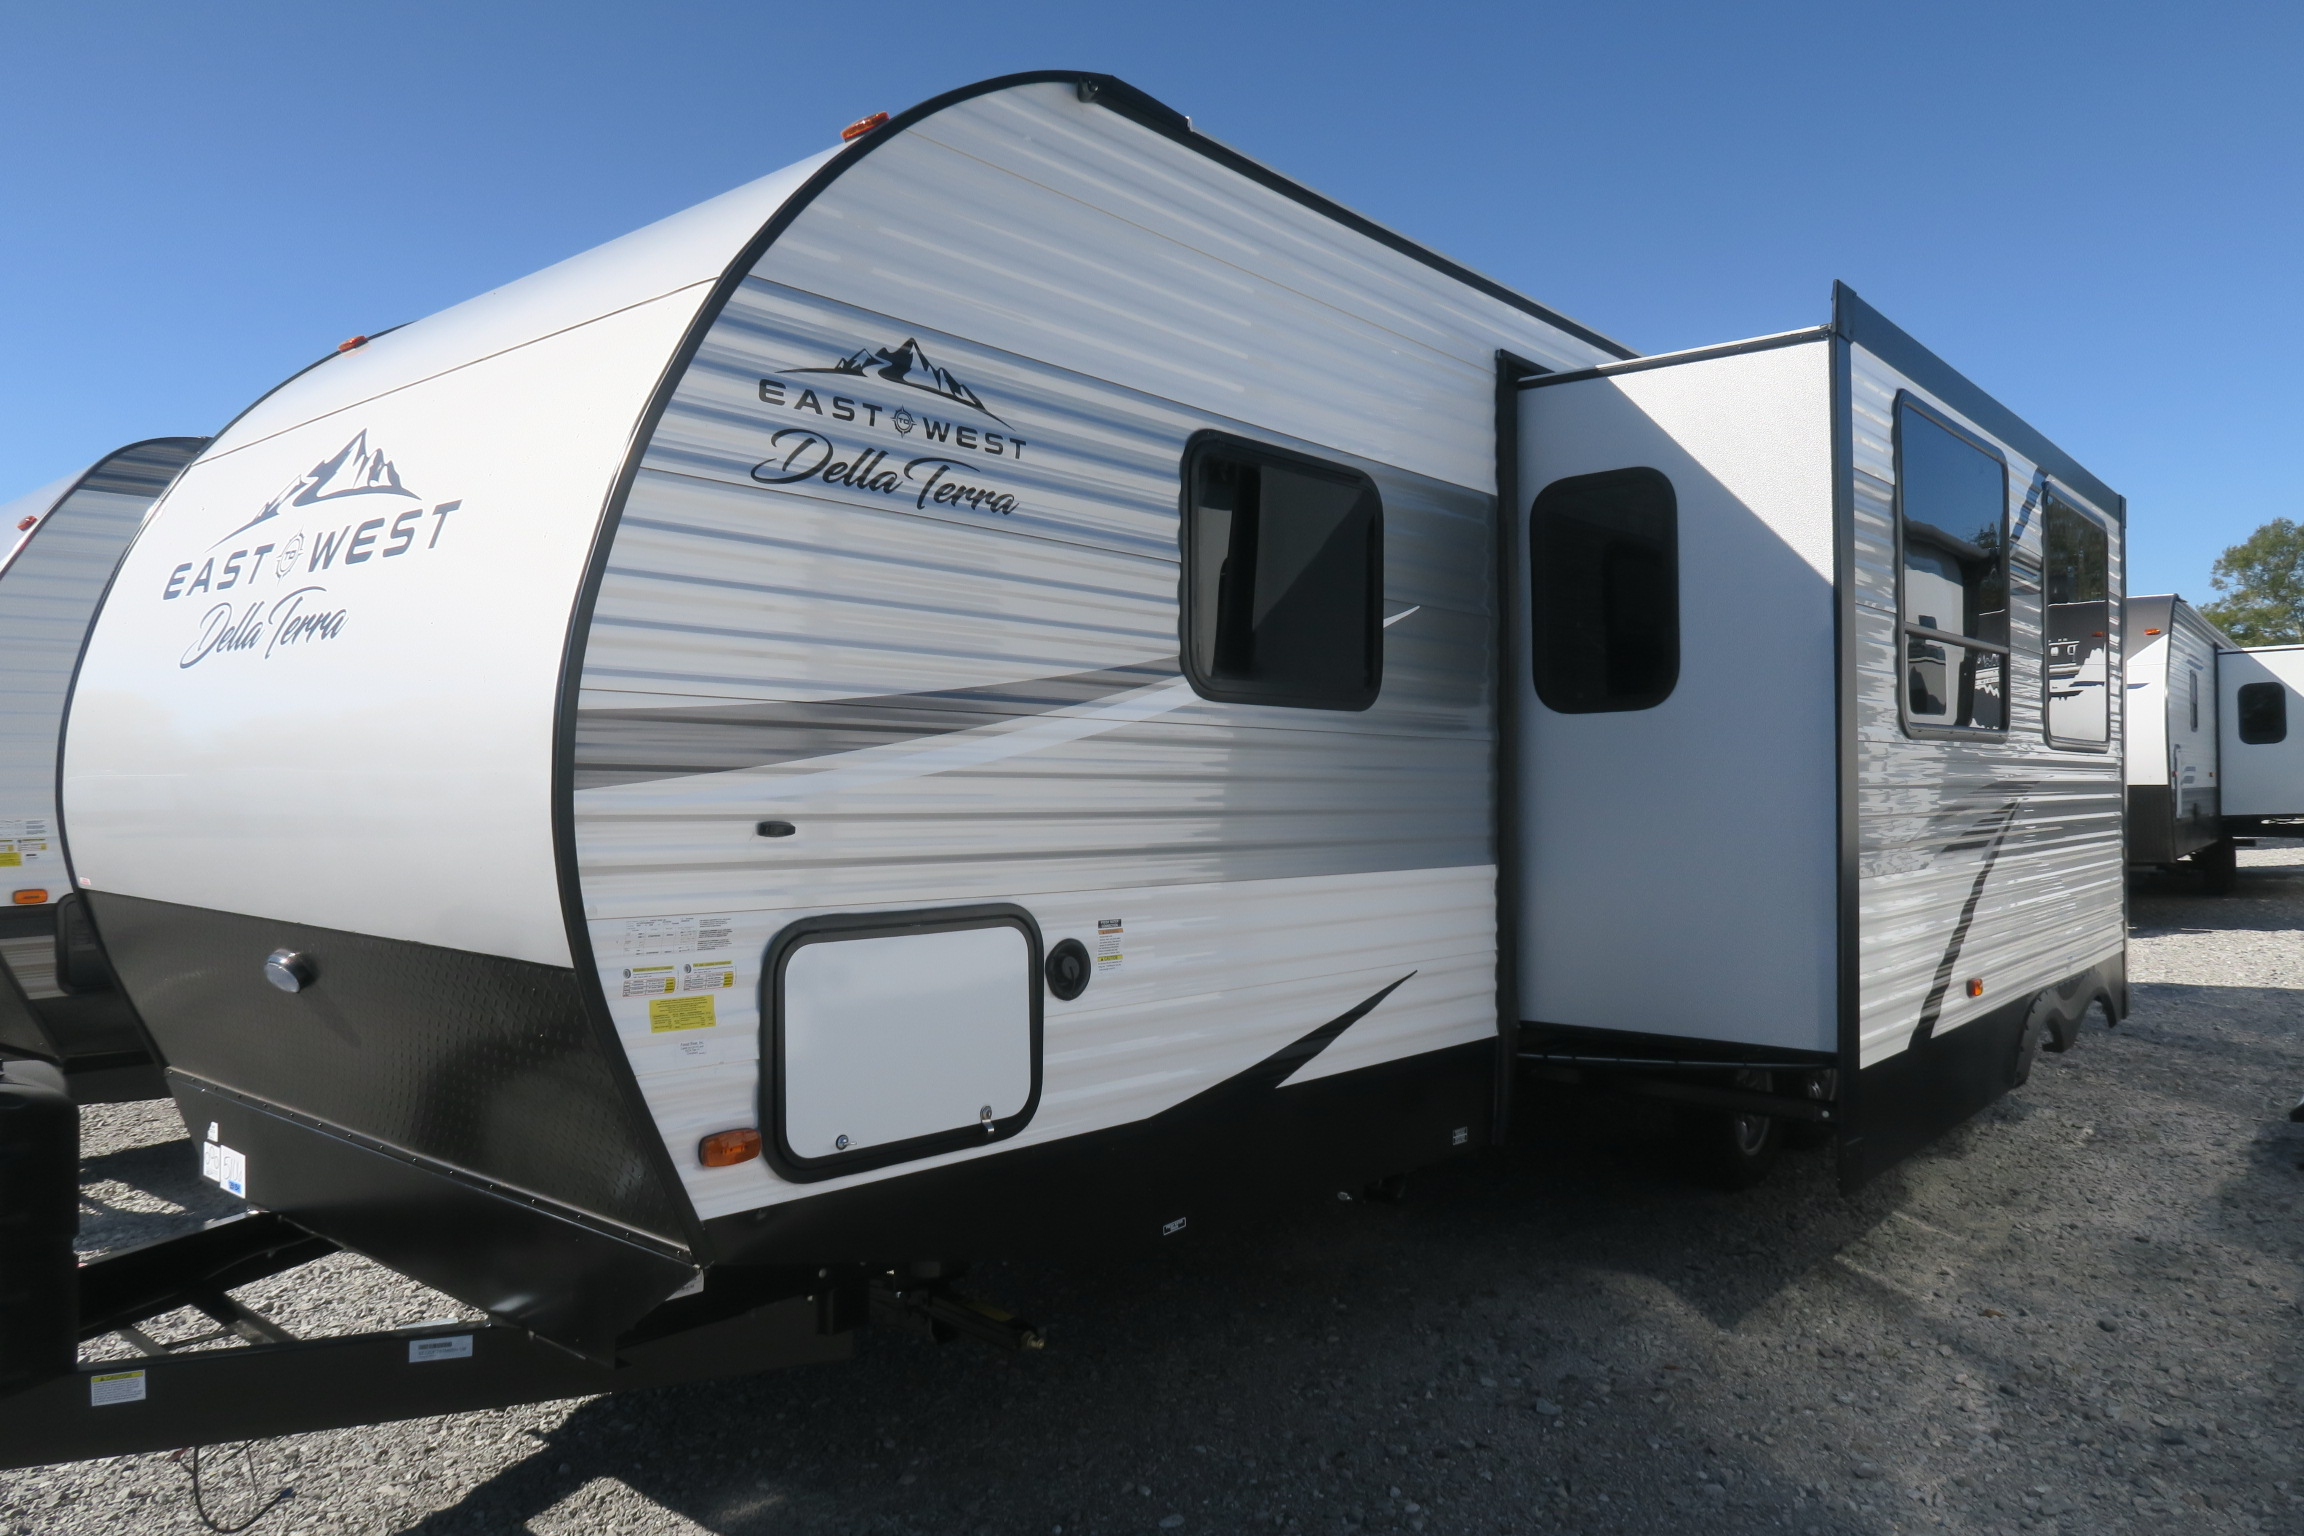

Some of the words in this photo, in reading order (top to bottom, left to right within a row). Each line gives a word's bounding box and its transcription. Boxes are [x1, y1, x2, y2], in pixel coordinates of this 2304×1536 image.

[758, 378, 883, 427] EAST
[898, 417, 910, 426] TO
[922, 416, 1027, 460] WEST
[750, 428, 903, 494] Della
[904, 457, 1020, 516] Terra
[162, 543, 276, 601] EAST
[307, 499, 463, 573] WEST
[179, 602, 266, 669] Della
[264, 586, 348, 660] Terra
